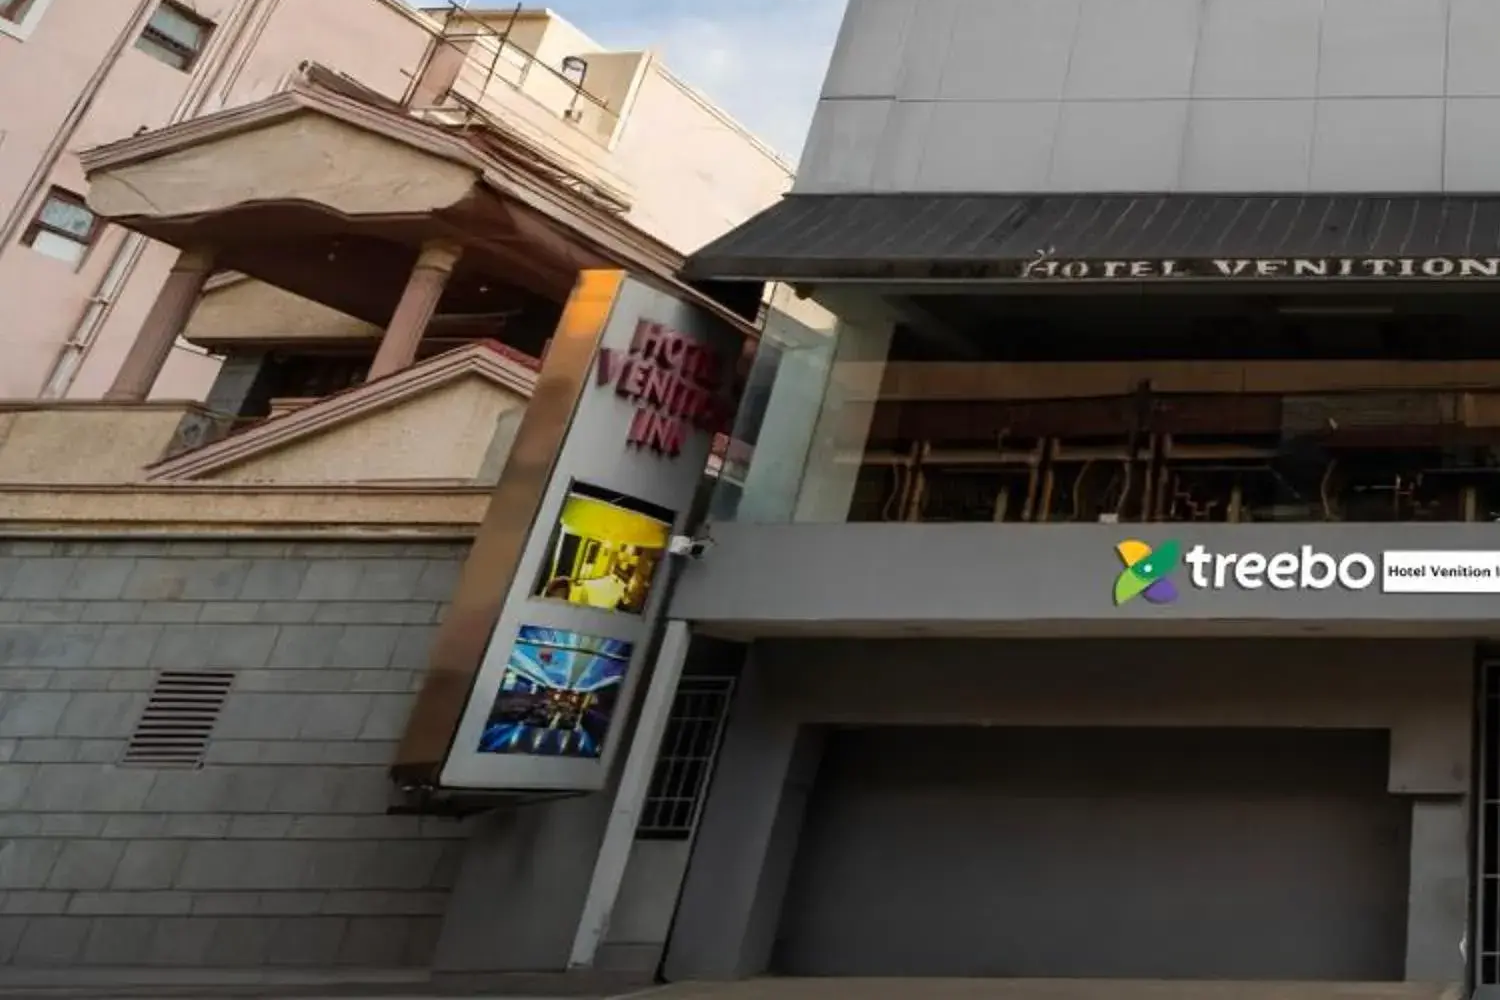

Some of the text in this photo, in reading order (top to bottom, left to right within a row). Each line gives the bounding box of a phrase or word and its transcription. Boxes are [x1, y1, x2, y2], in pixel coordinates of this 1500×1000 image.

[1020, 247, 1190, 279] HOTEL
[630, 319, 724, 388] HOT
[1184, 544, 1376, 590] treebo
[1387, 564, 1427, 578] Hotel
[1430, 564, 1491, 578] Venition
